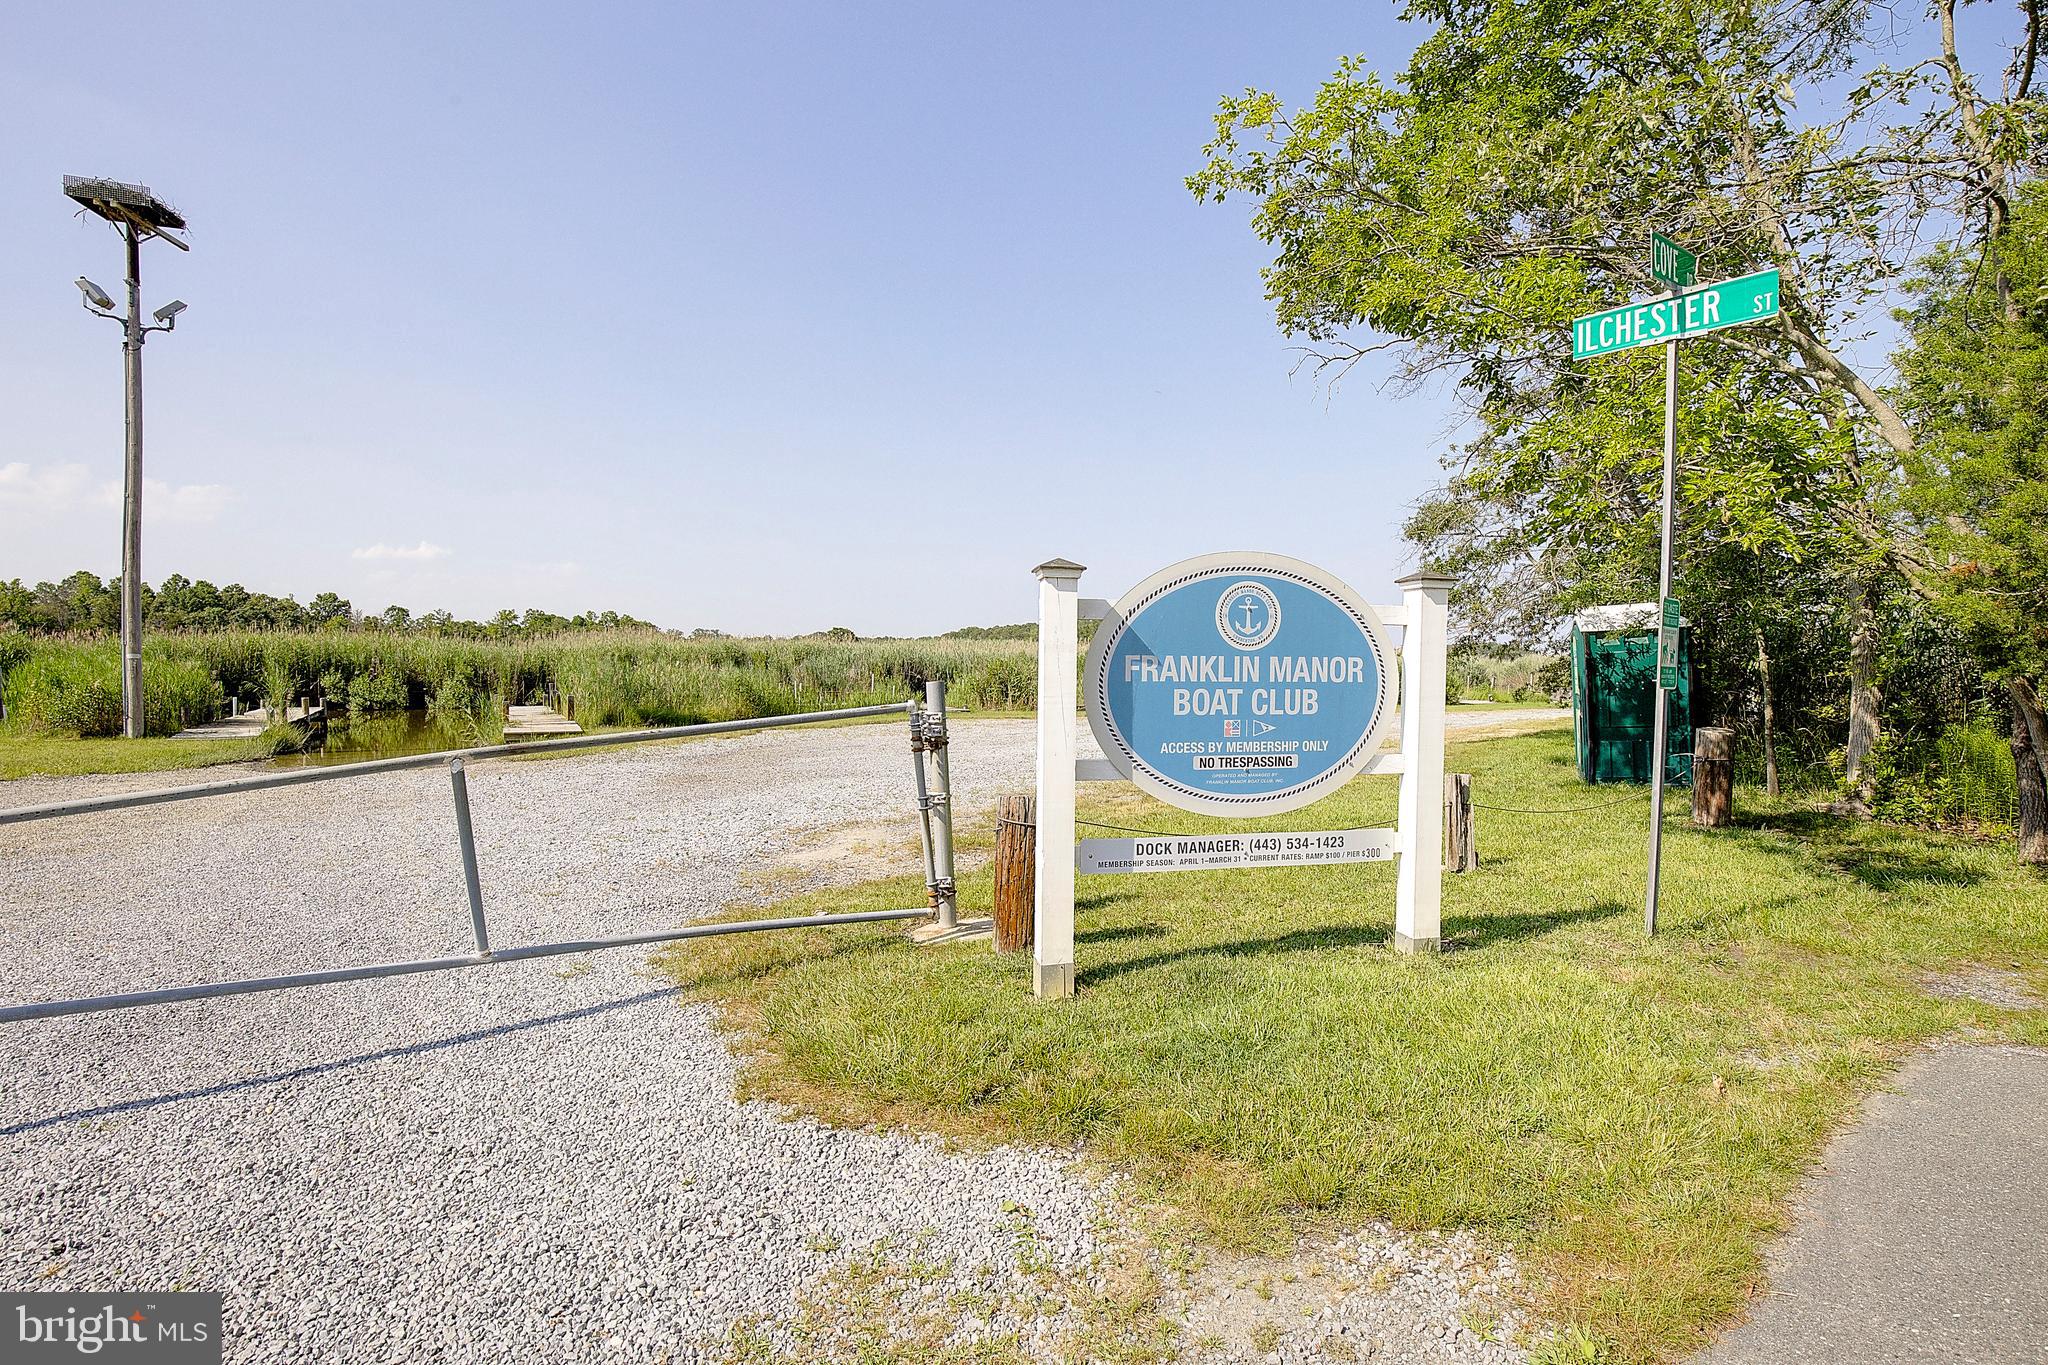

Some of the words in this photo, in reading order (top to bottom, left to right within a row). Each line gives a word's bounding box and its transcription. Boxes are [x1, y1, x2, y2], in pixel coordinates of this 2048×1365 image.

[1654, 239, 1678, 282] COVE
[1578, 290, 1720, 353] ILCHESTER
[1753, 292, 1773, 313] ST
[1124, 655, 1261, 682] FRANKLIN
[1269, 656, 1364, 683] MANOR
[1173, 688, 1243, 716] BOAT
[1251, 688, 1319, 716] CLUB
[1160, 743, 1204, 754] ACCESS
[1208, 742, 1223, 753] BY
[1226, 741, 1299, 753] MEMBERSHIP
[1302, 740, 1329, 752] ONLY
[1199, 757, 1215, 769] NO
[1218, 756, 1293, 768] TRESPASSING
[1097, 860, 1144, 868] MEMBERSHIP
[1146, 859, 1176, 867] SEASON:
[1179, 857, 1199, 865] APRIL
[1249, 853, 1279, 862] CURRENT
[1281, 853, 1303, 861] RATES:
[1305, 852, 1324, 860] RAMP
[1325, 851, 1341, 859] $100
[1346, 850, 1361, 858] PIER
[1361, 847, 1381, 858] $300
[1136, 842, 1172, 856] DOCK
[1177, 839, 1244, 854] MANAGER:
[1249, 838, 1281, 853] (443)
[1286, 836, 1345, 850] 534-1423
